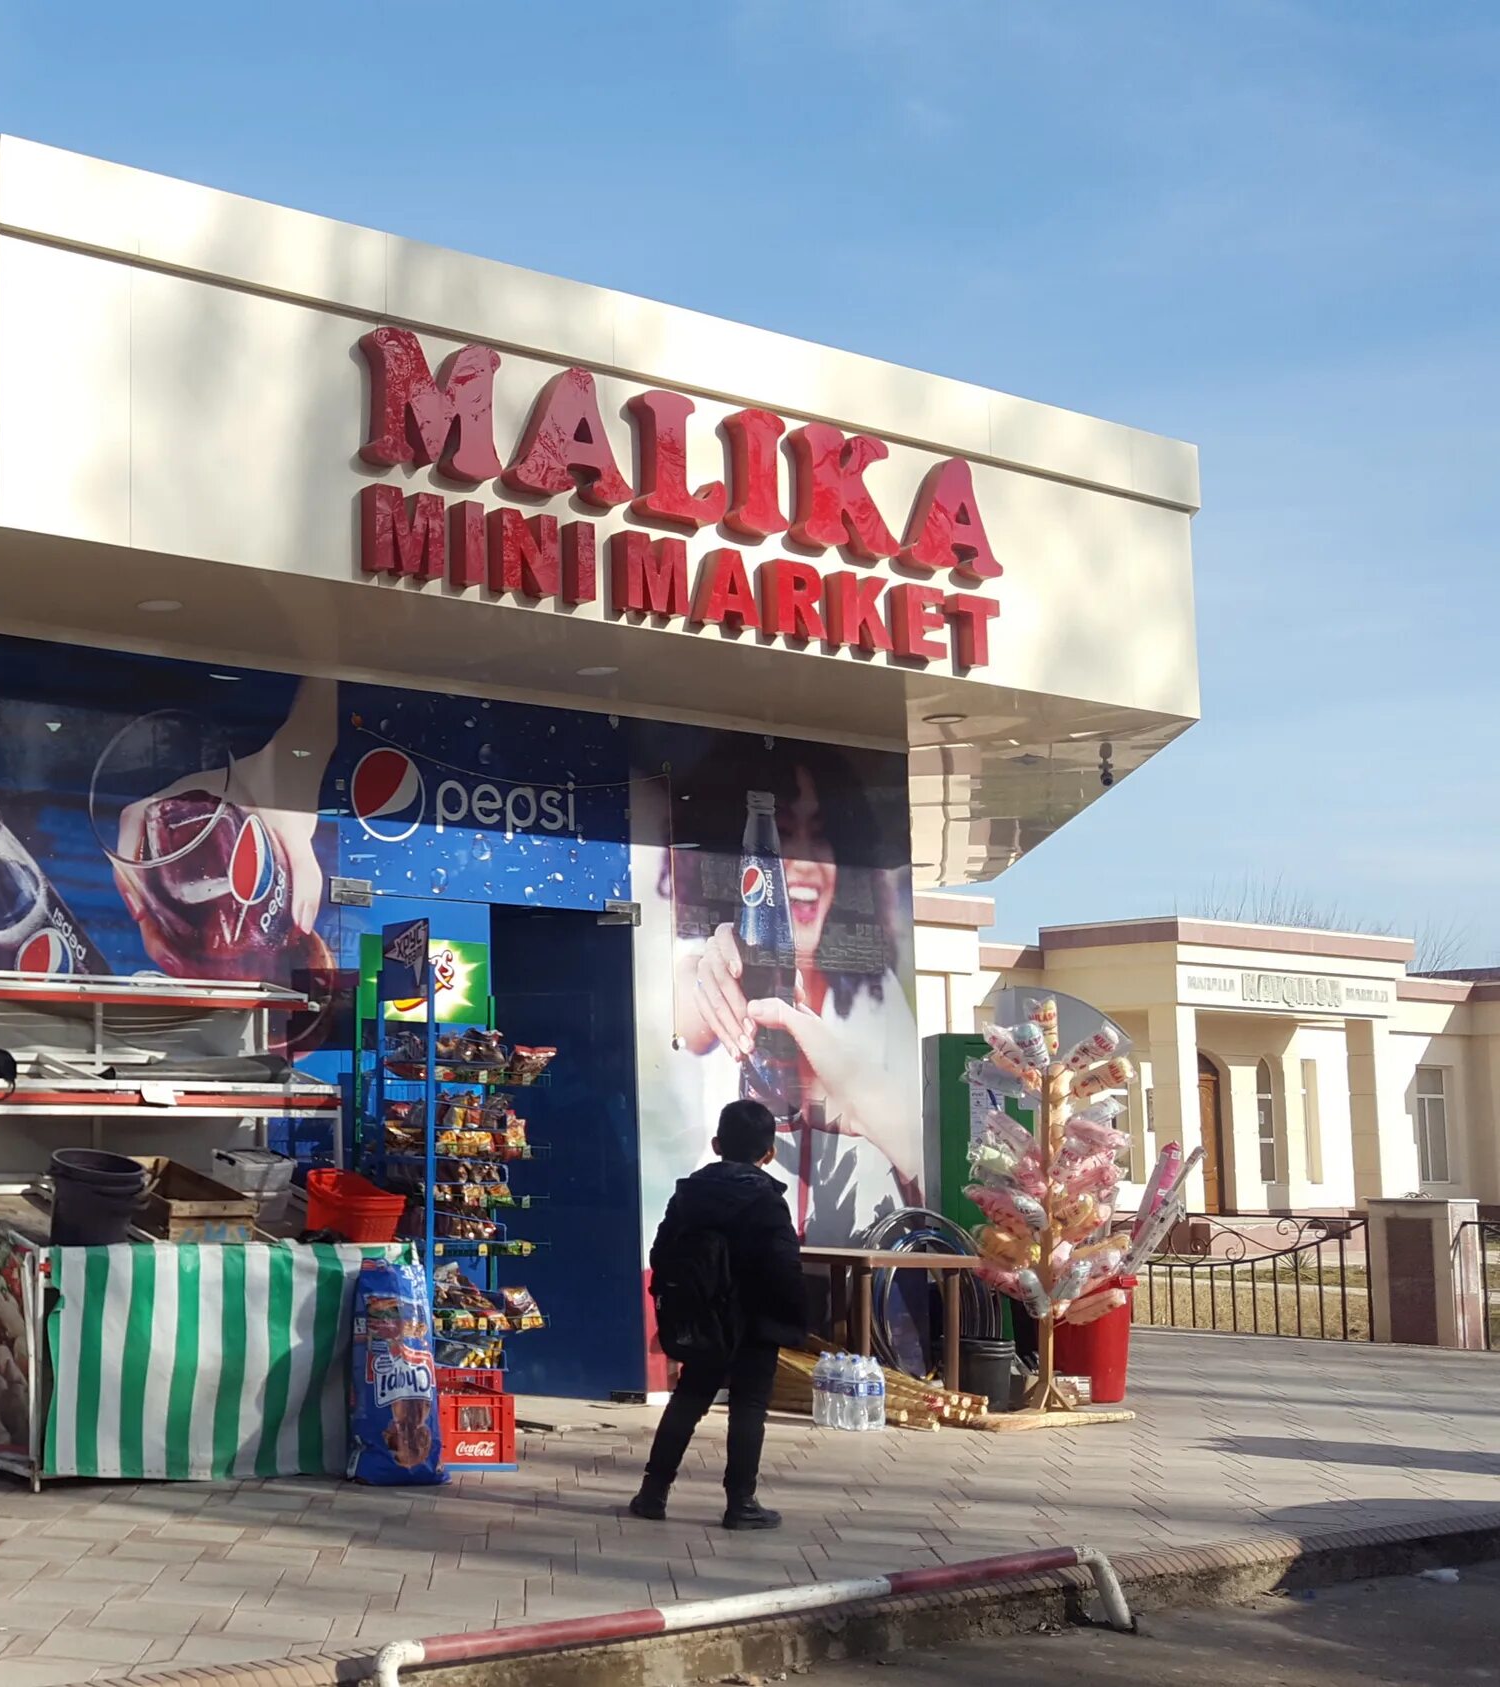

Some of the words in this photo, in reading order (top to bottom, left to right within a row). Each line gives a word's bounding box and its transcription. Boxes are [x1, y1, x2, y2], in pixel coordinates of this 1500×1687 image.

[359, 326, 1003, 580] MALIKA
[360, 483, 596, 604] MINI
[612, 530, 999, 669] MARKET
[436, 780, 575, 840] pepsi
[259, 864, 287, 933] pepsi
[764, 869, 775, 907] pepsi
[52, 908, 86, 961] pepsi
